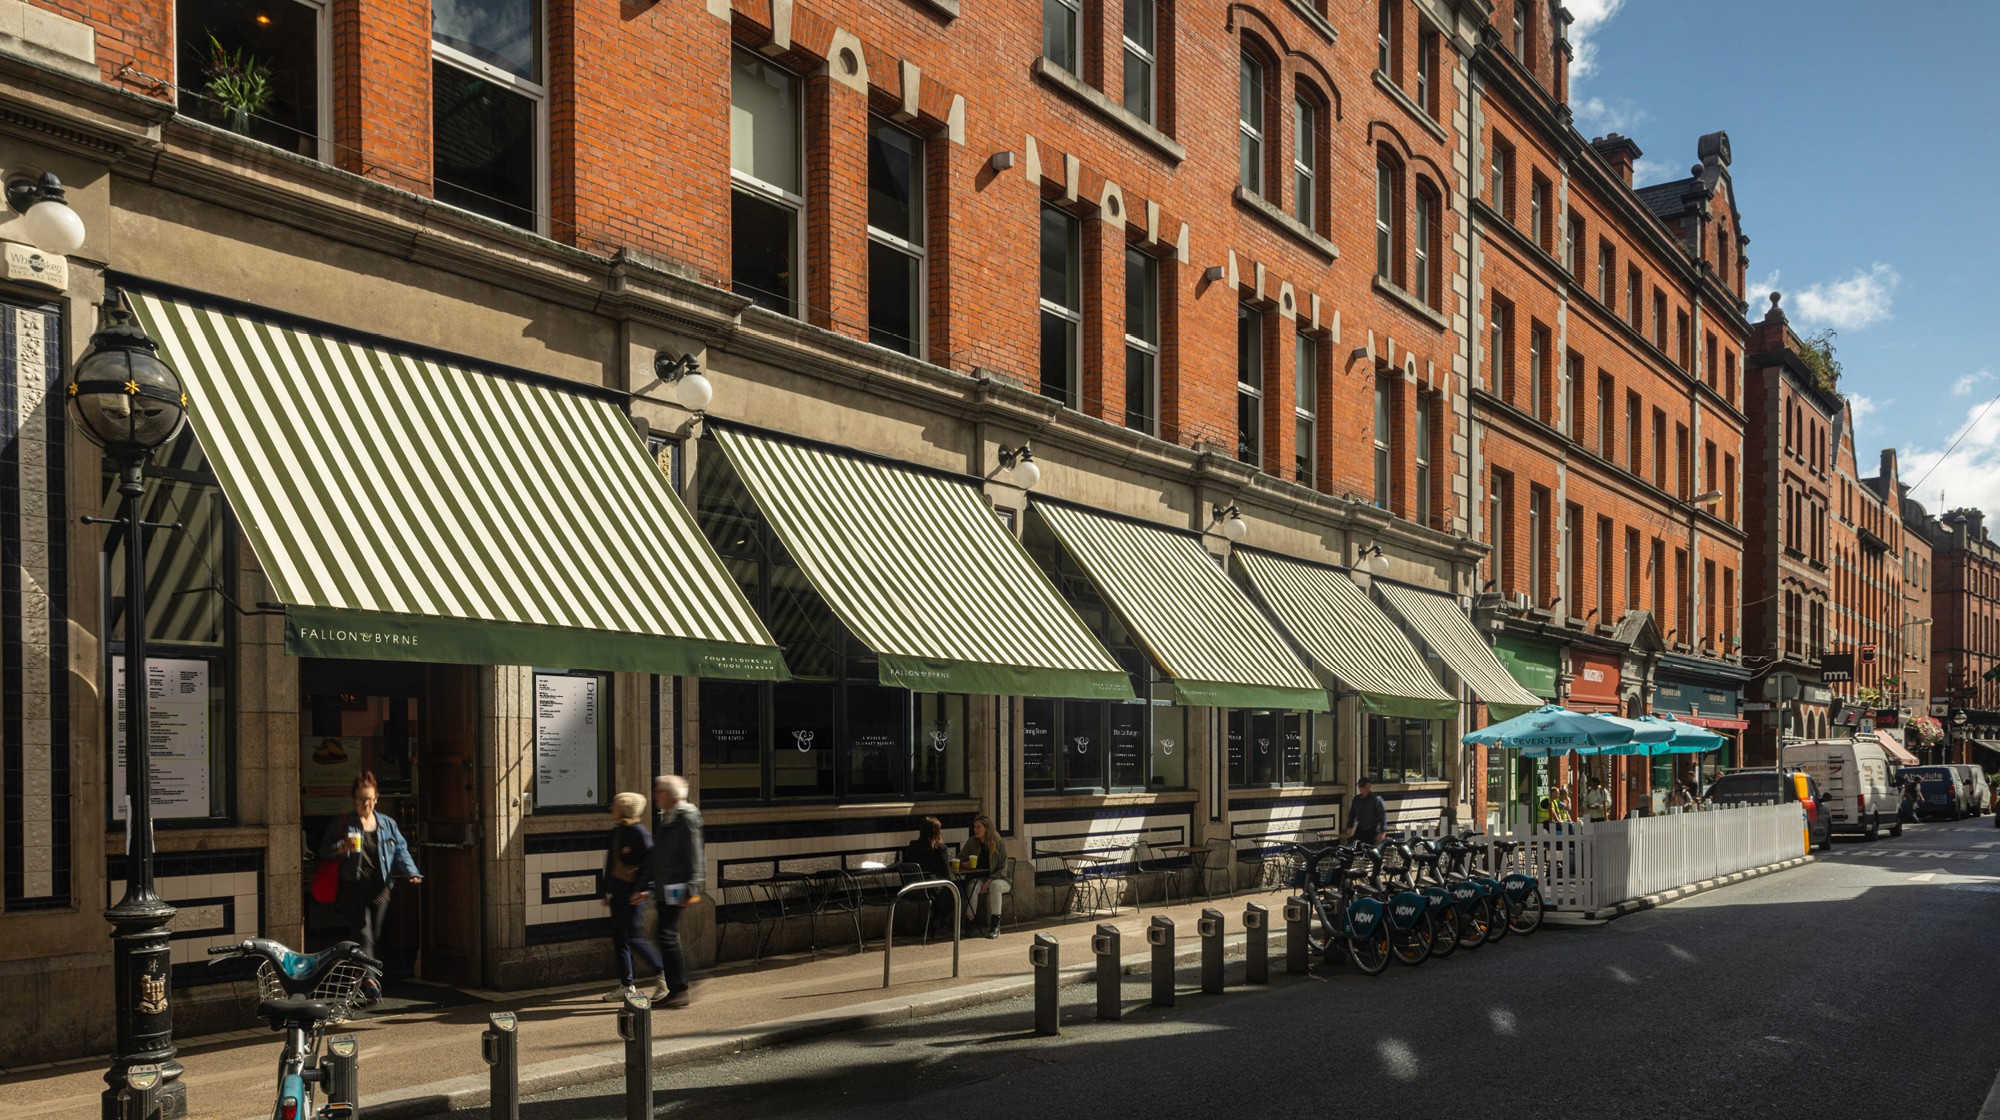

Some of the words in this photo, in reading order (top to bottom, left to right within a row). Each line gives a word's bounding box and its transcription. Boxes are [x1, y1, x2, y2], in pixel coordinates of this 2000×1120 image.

[300, 628, 357, 641] FALLON
[375, 633, 418, 646] BYRNE
[585, 682, 595, 725] Dining
[1513, 736, 1574, 745] FEVER-TREE
[1505, 880, 1525, 890] NOW
[1396, 905, 1415, 916] NOW
[1354, 911, 1374, 924] NOW
